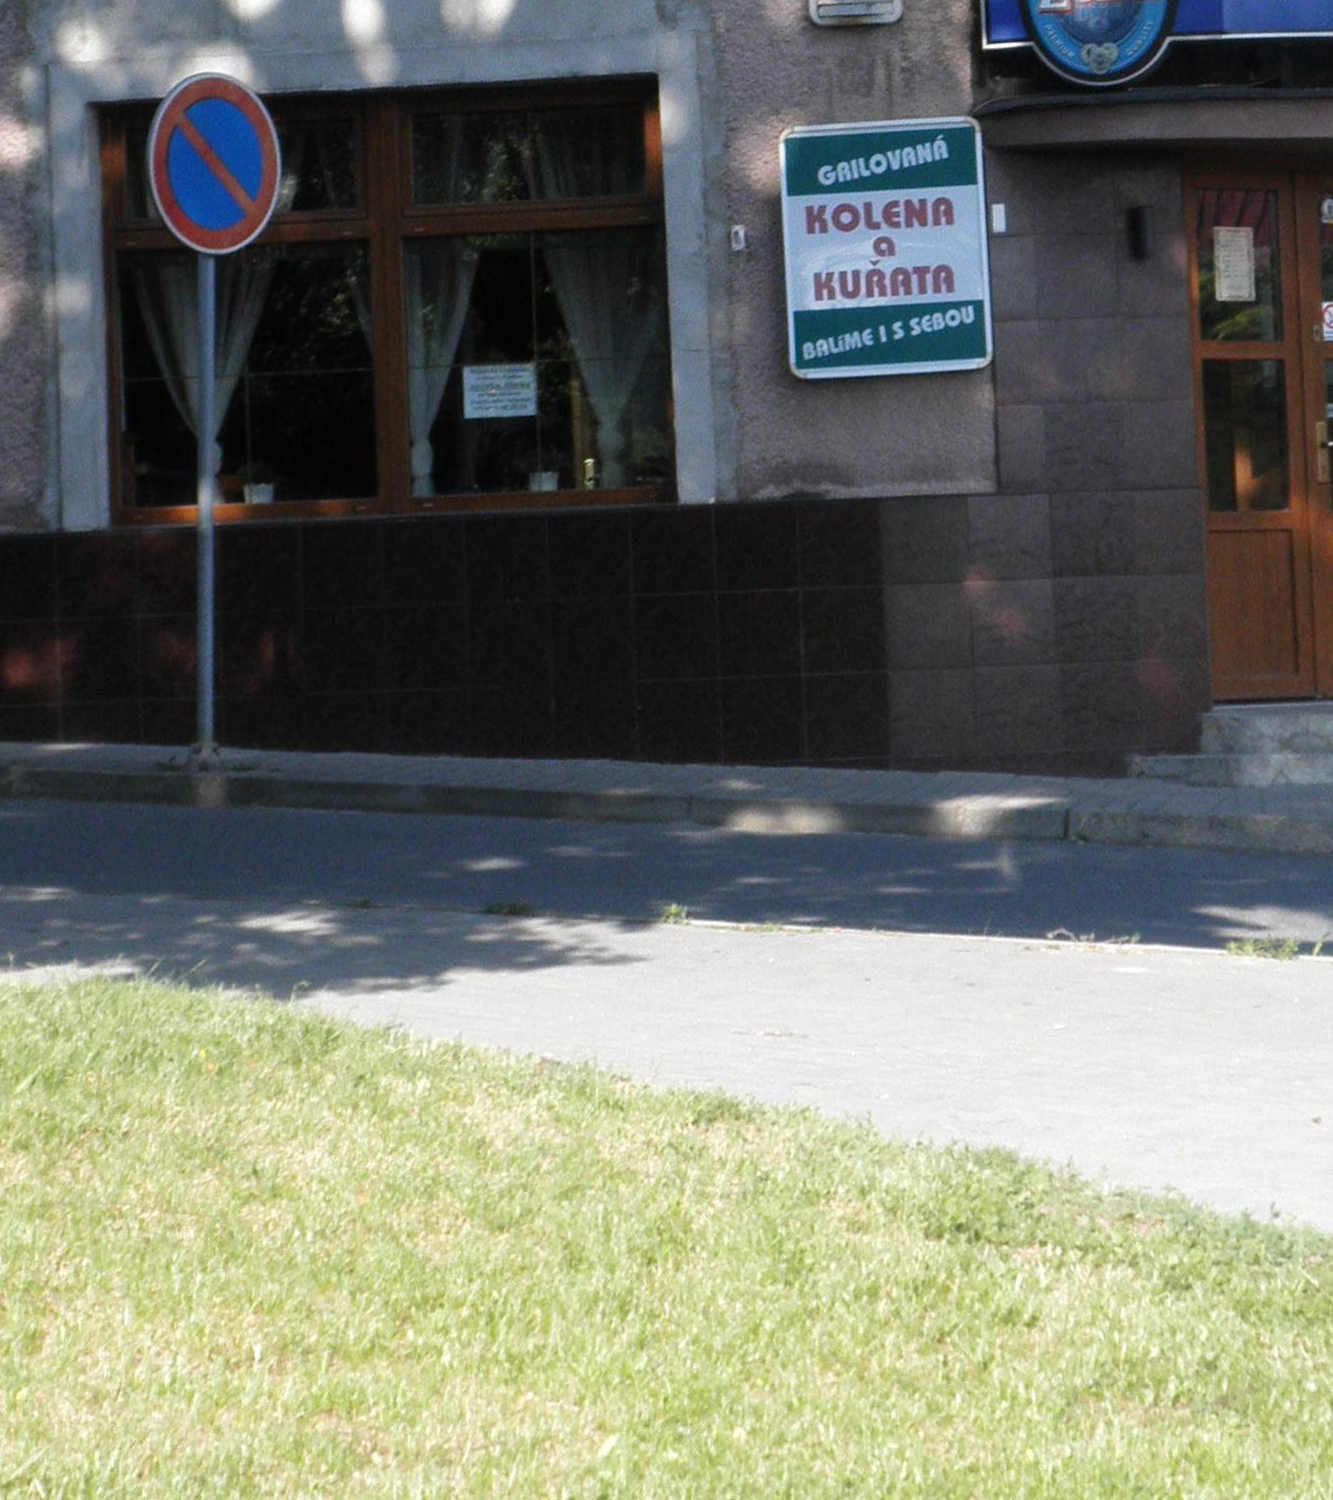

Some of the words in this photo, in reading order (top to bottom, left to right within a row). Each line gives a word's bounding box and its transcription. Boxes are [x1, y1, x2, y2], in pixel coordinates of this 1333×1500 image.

[817, 135, 949, 186] GRILOVANÁ
[805, 197, 954, 234] KOLENA
[813, 260, 955, 301] KUŘATA
[879, 325, 886, 343] I
[893, 321, 904, 340] S
[910, 305, 975, 336] SEBOU
